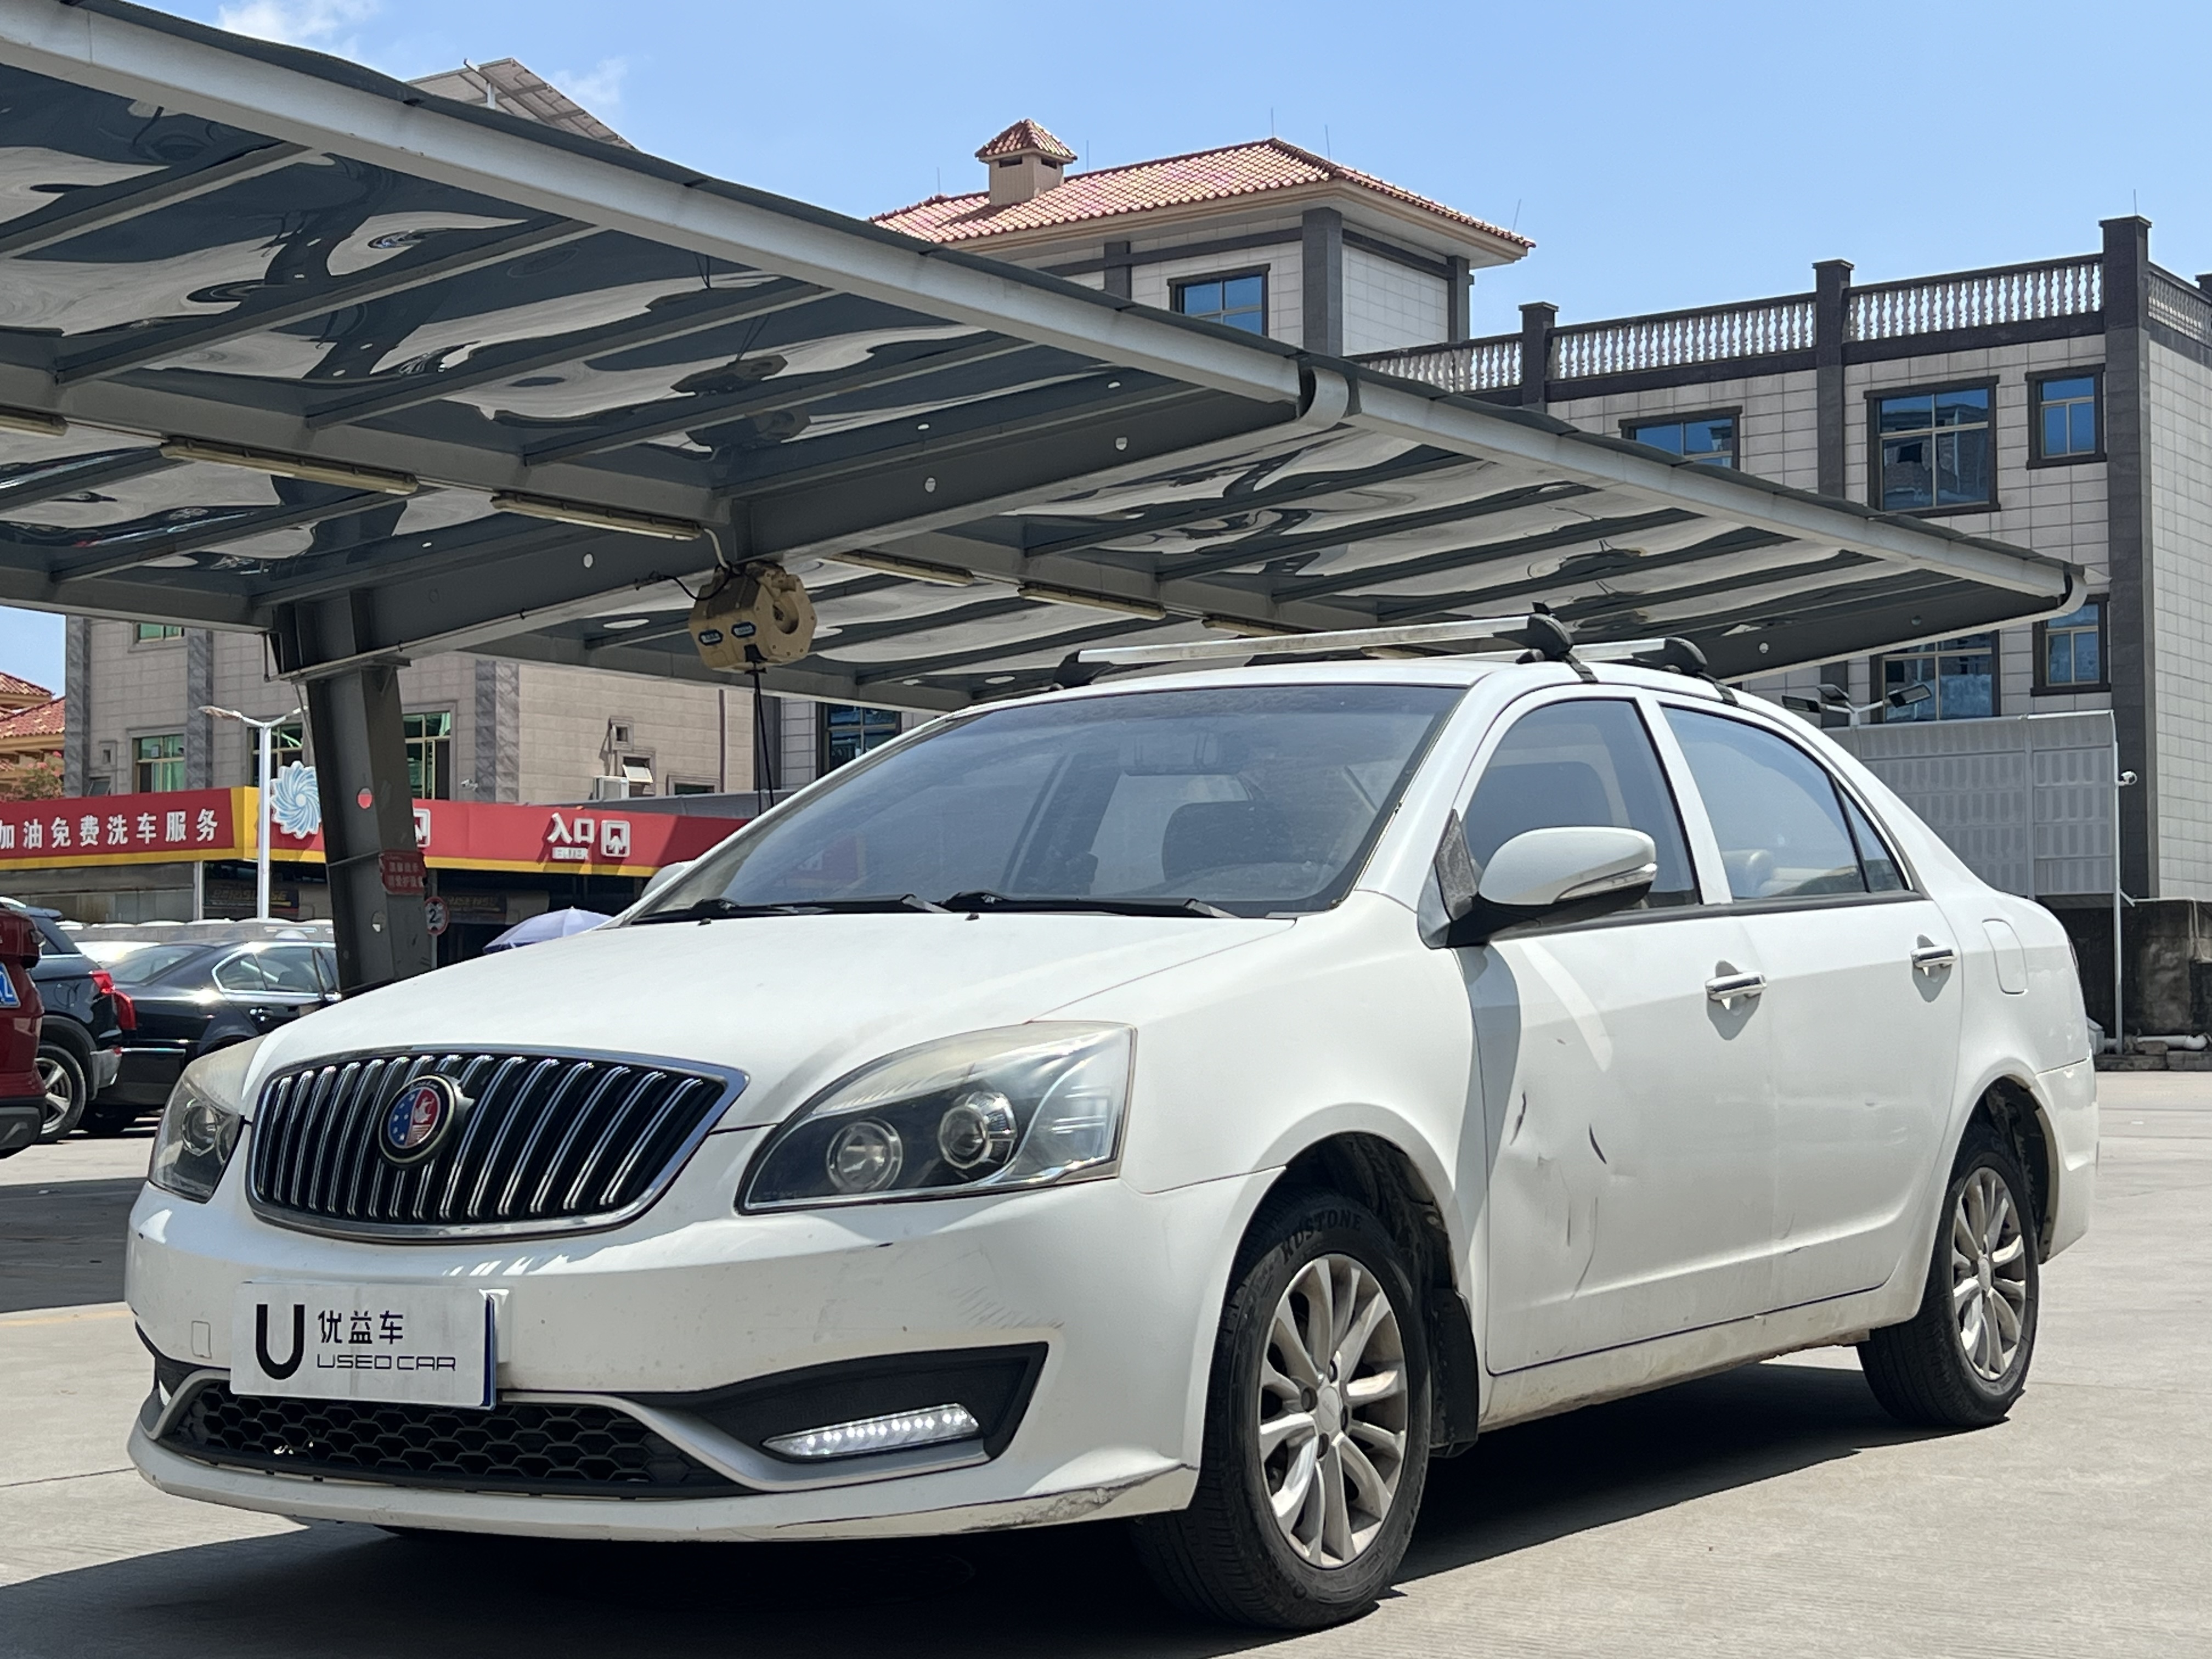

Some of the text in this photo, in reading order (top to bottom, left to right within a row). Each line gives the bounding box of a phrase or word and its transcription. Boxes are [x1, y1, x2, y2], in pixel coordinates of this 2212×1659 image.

[0, 809, 218, 850] 加油免费洗车服务
[547, 812, 595, 844] 入口
[256, 1304, 305, 1380] U
[318, 1310, 404, 1344] 优益车
[317, 1354, 456, 1372] USED CAR
